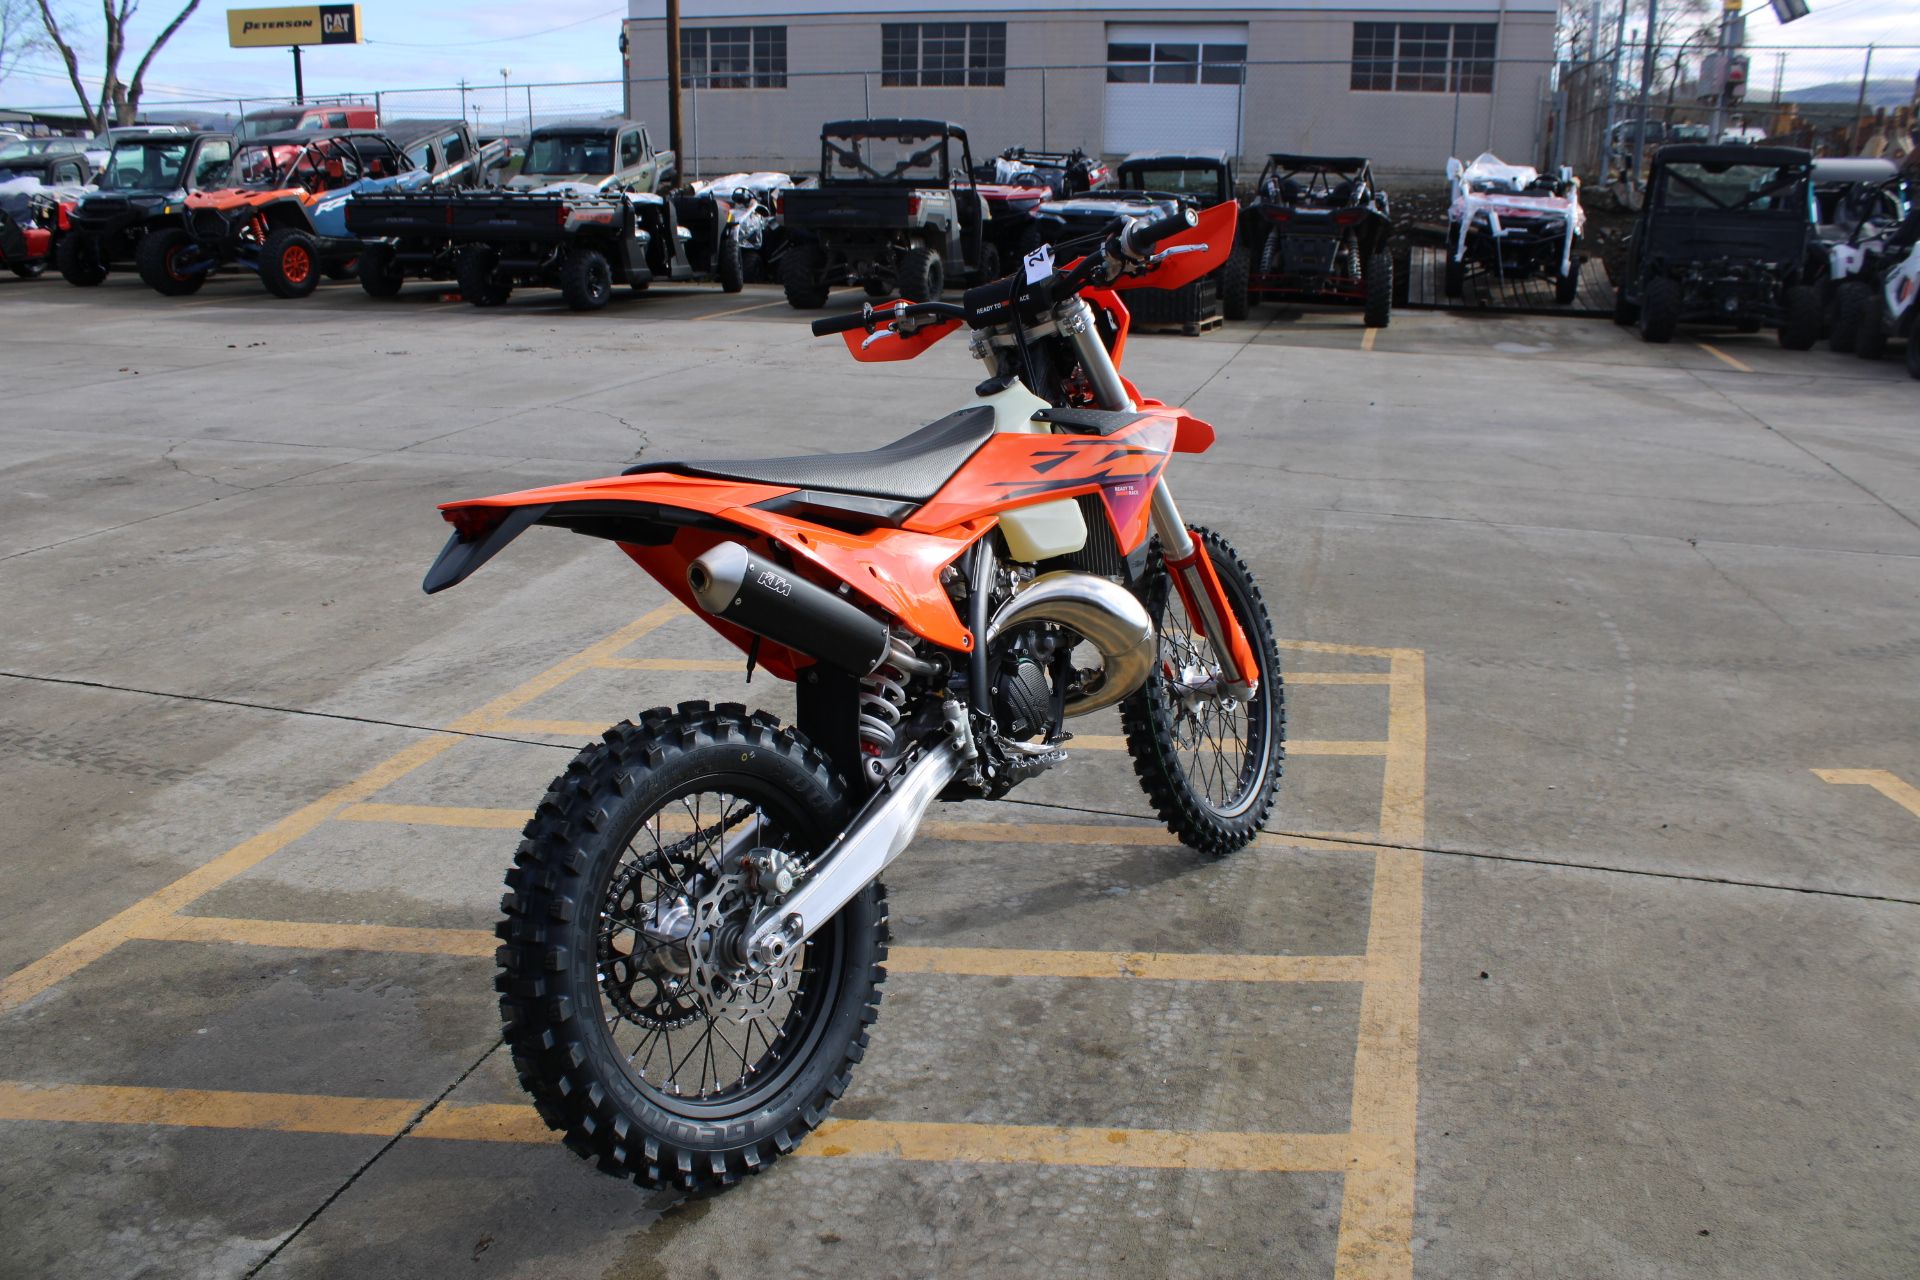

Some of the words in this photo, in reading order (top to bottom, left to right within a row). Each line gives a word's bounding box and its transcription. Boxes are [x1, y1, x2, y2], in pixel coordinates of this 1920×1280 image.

[242, 20, 313, 34] PETERSON
[323, 13, 350, 33] CAT
[976, 303, 994, 315] READY
[1019, 294, 1030, 302] ACE
[757, 571, 792, 597] KTM
